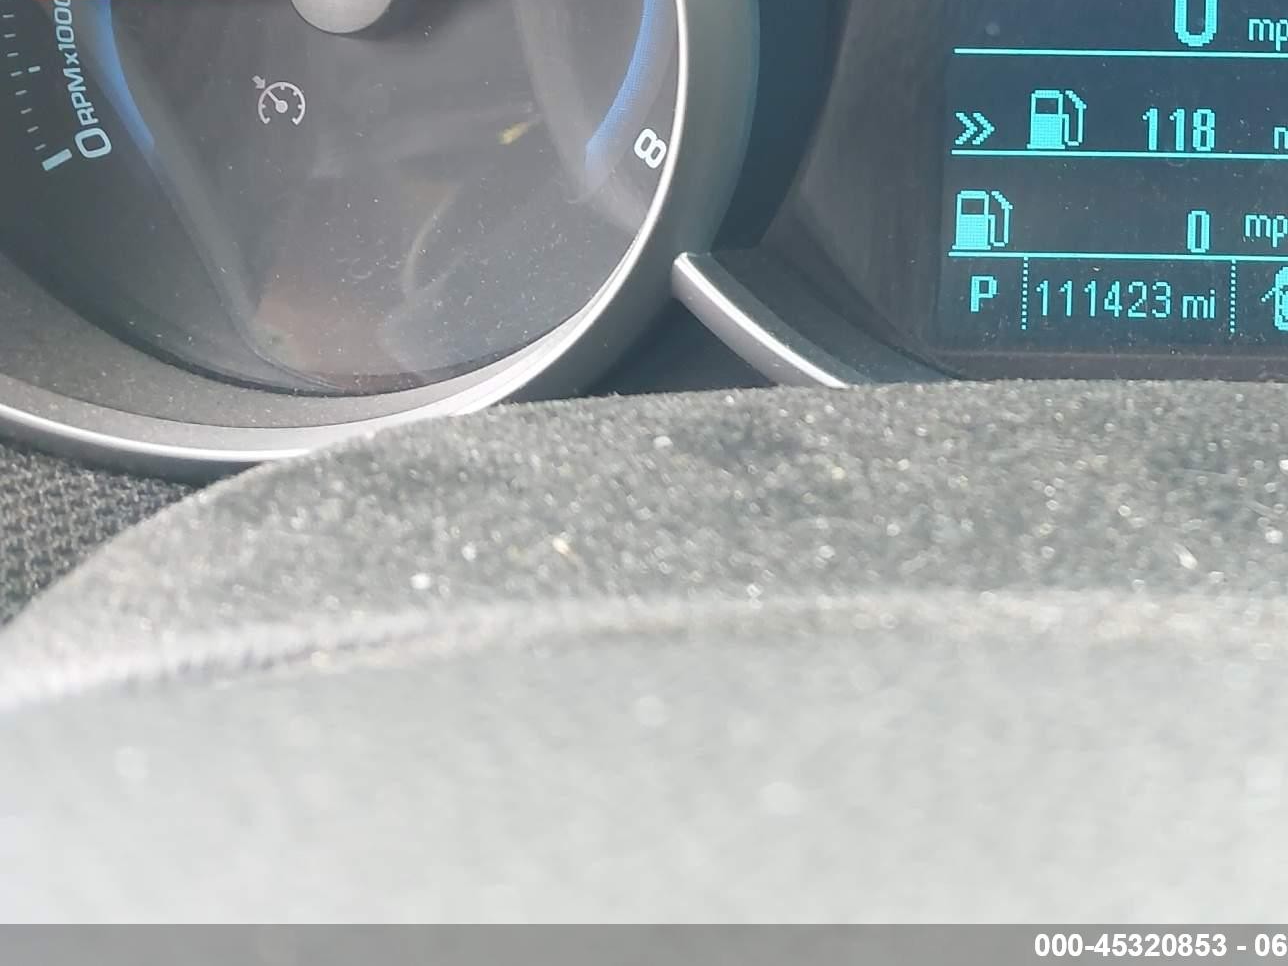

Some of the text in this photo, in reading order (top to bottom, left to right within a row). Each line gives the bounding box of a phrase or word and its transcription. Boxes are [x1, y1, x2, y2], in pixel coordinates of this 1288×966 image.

[75, 128, 112, 158] 0
[634, 128, 667, 169] 8
[1142, 107, 1215, 152] 118
[1187, 210, 1210, 253] 0
[970, 276, 998, 312] P
[1036, 280, 1215, 320] 111423 mi
